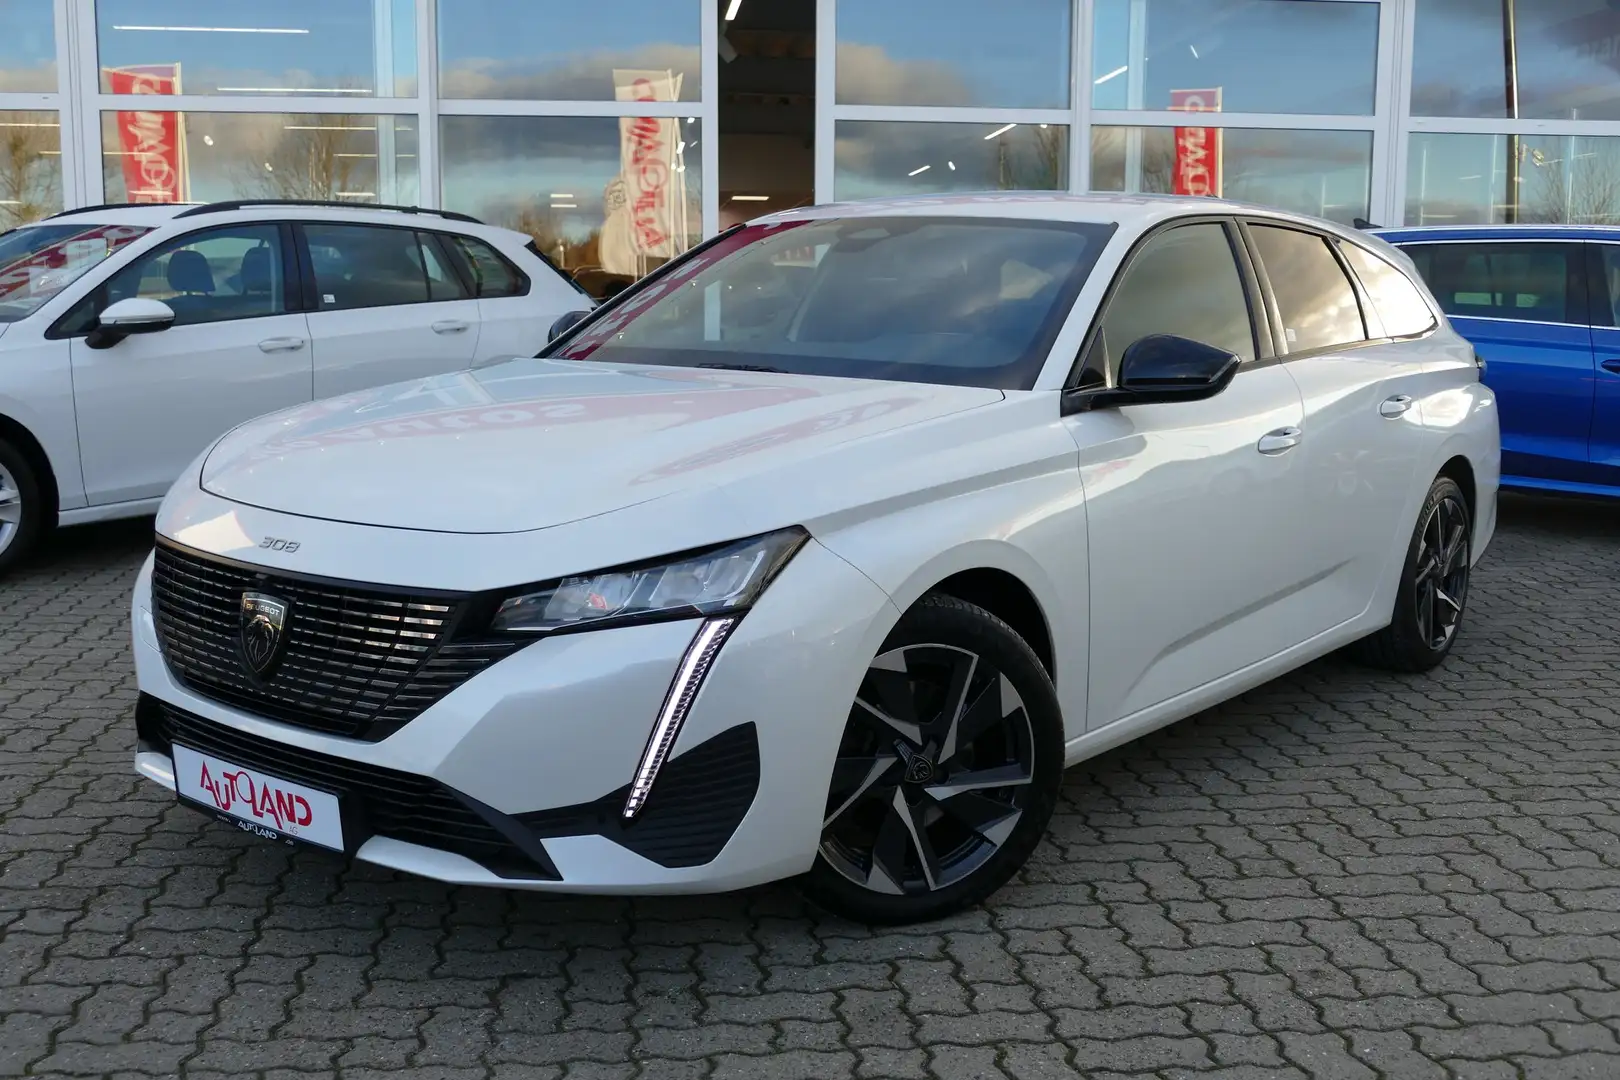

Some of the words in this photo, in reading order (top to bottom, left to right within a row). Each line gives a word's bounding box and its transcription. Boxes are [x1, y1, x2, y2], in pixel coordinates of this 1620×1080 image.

[259, 535, 301, 553] 308
[246, 602, 280, 616] PEUGEOT
[200, 760, 313, 831] AUTOLAND
[237, 820, 278, 840] AUTOLAND
